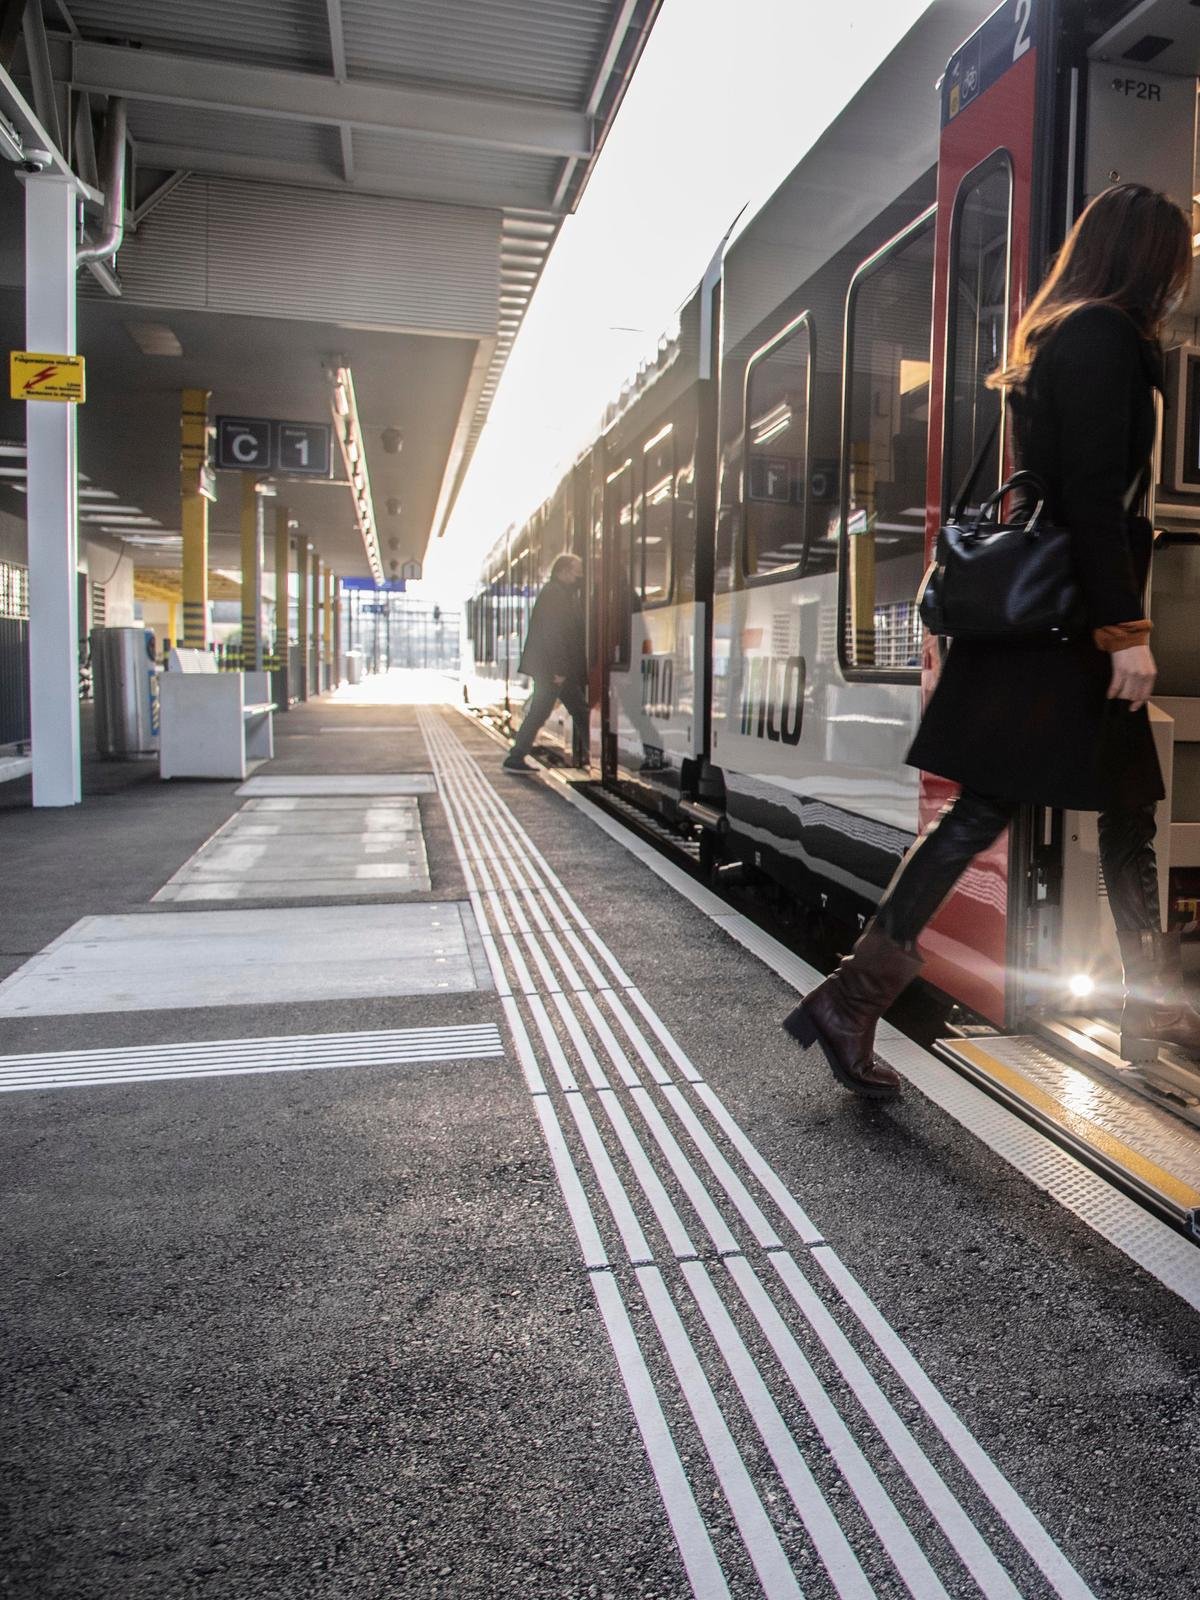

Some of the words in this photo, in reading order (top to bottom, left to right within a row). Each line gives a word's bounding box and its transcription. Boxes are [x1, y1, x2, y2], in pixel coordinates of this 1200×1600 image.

[1012, 0, 1032, 62] 2
[1124, 79, 1161, 102] F2R
[232, 433, 259, 462] C
[294, 439, 309, 466] 1
